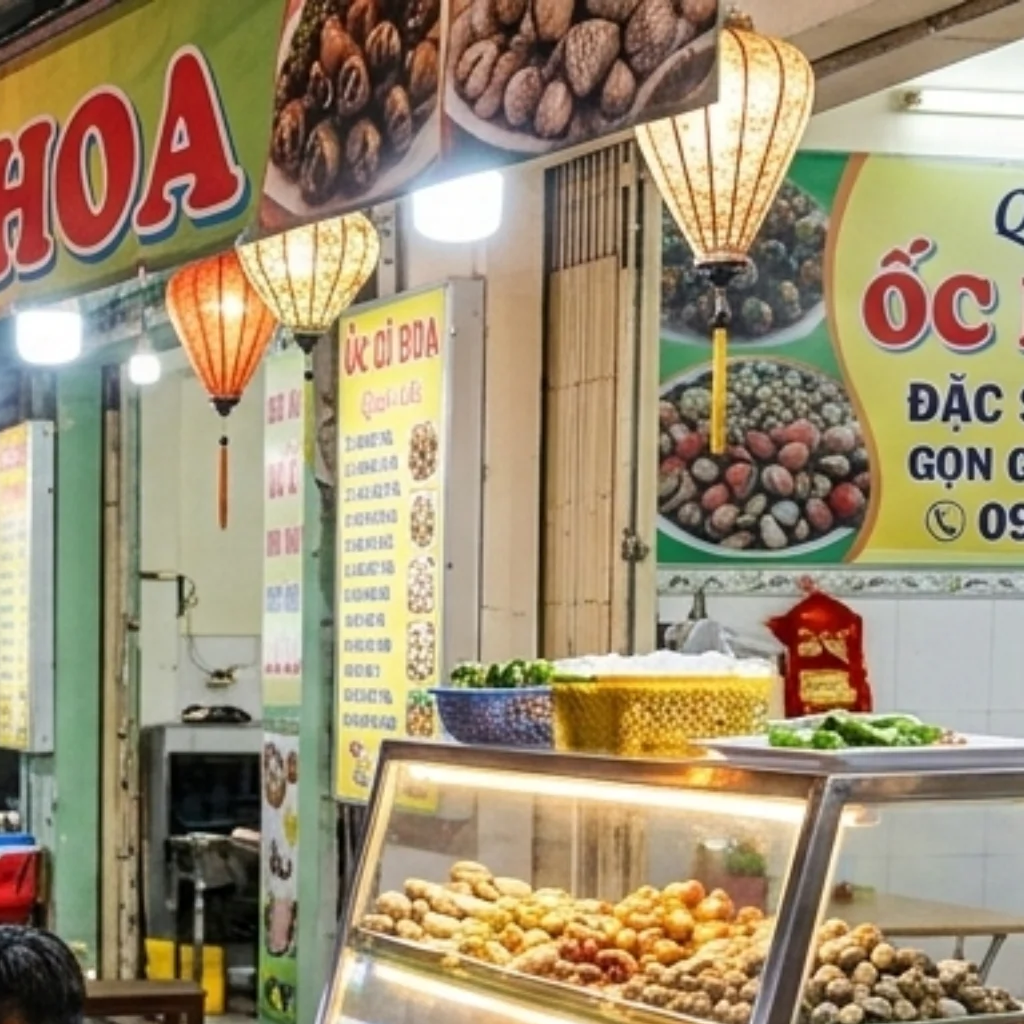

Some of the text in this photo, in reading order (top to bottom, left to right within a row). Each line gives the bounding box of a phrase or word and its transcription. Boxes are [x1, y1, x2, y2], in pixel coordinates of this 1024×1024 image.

[862, 238, 998, 353] ỐC
[907, 373, 1003, 432] ĐẶC
[909, 446, 992, 489] GỌN
